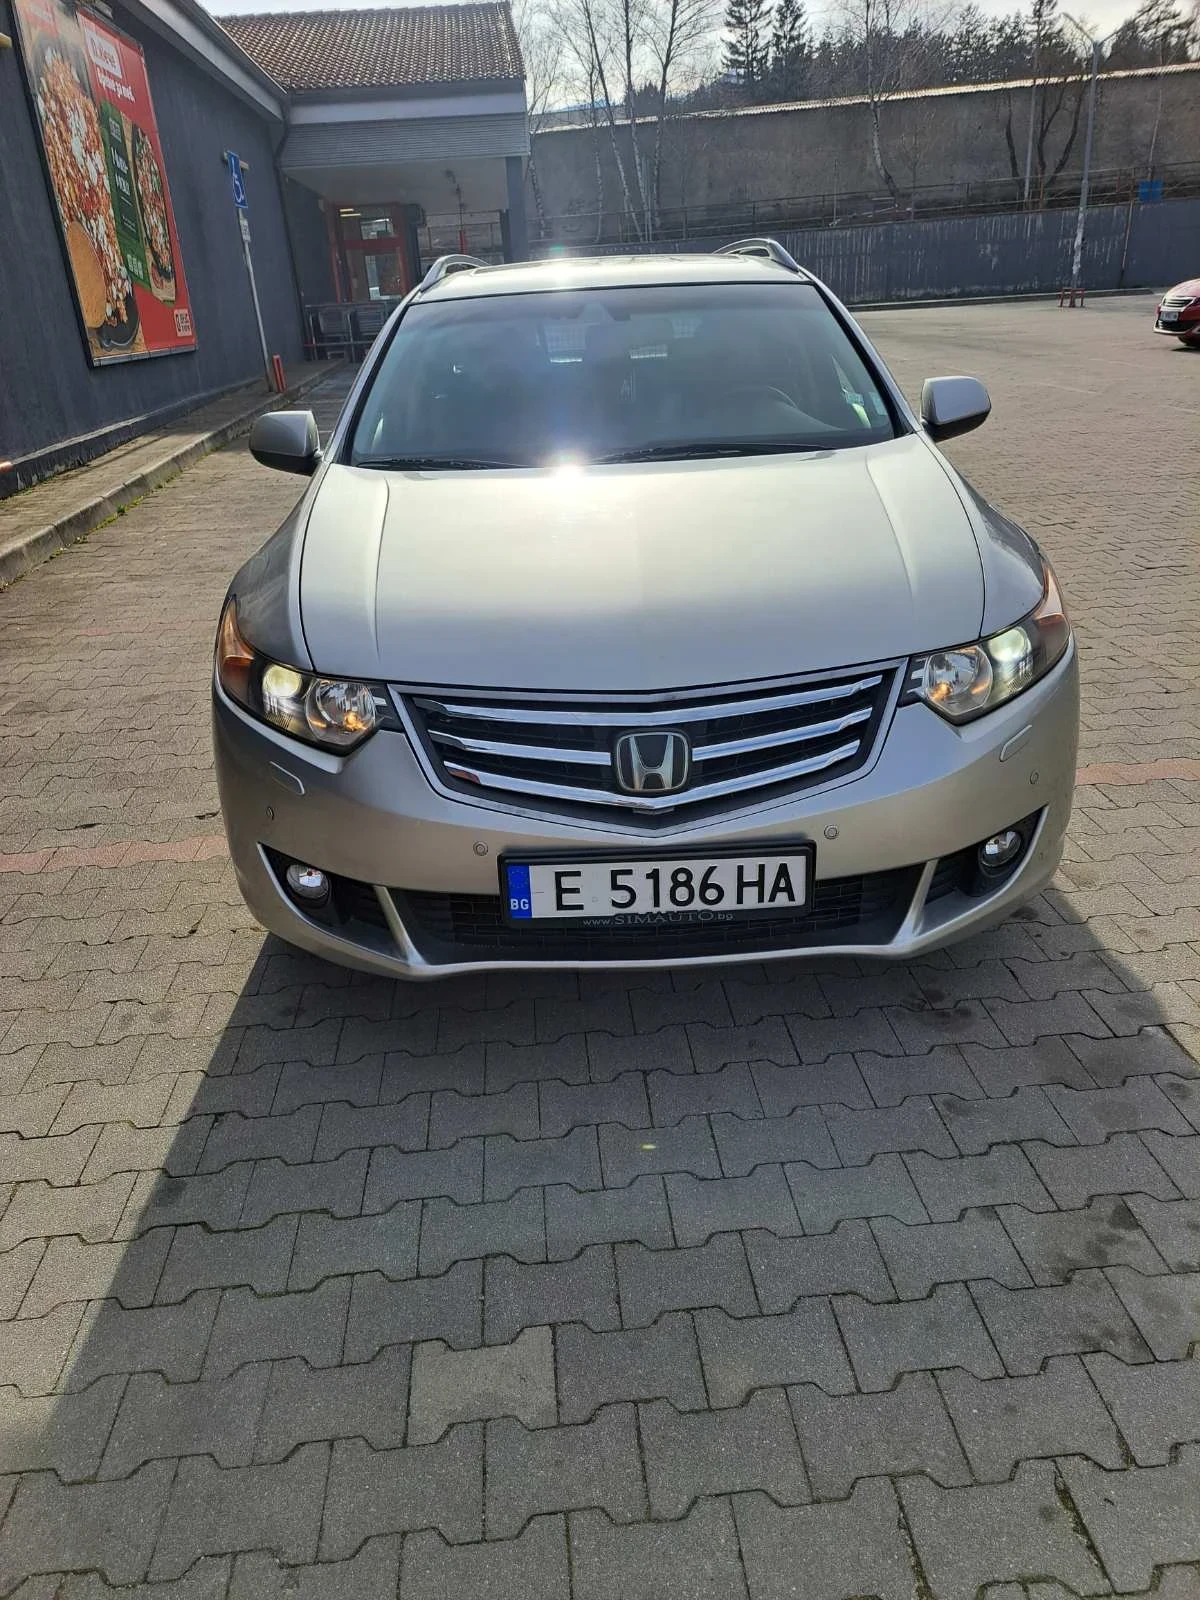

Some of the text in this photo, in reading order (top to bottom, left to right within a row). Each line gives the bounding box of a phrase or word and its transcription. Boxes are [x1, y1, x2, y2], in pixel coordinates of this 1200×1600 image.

[554, 863, 796, 911] E 5186 HA
[510, 898, 529, 911] BG
[582, 909, 735, 927] www.SIMAUTO.bg
